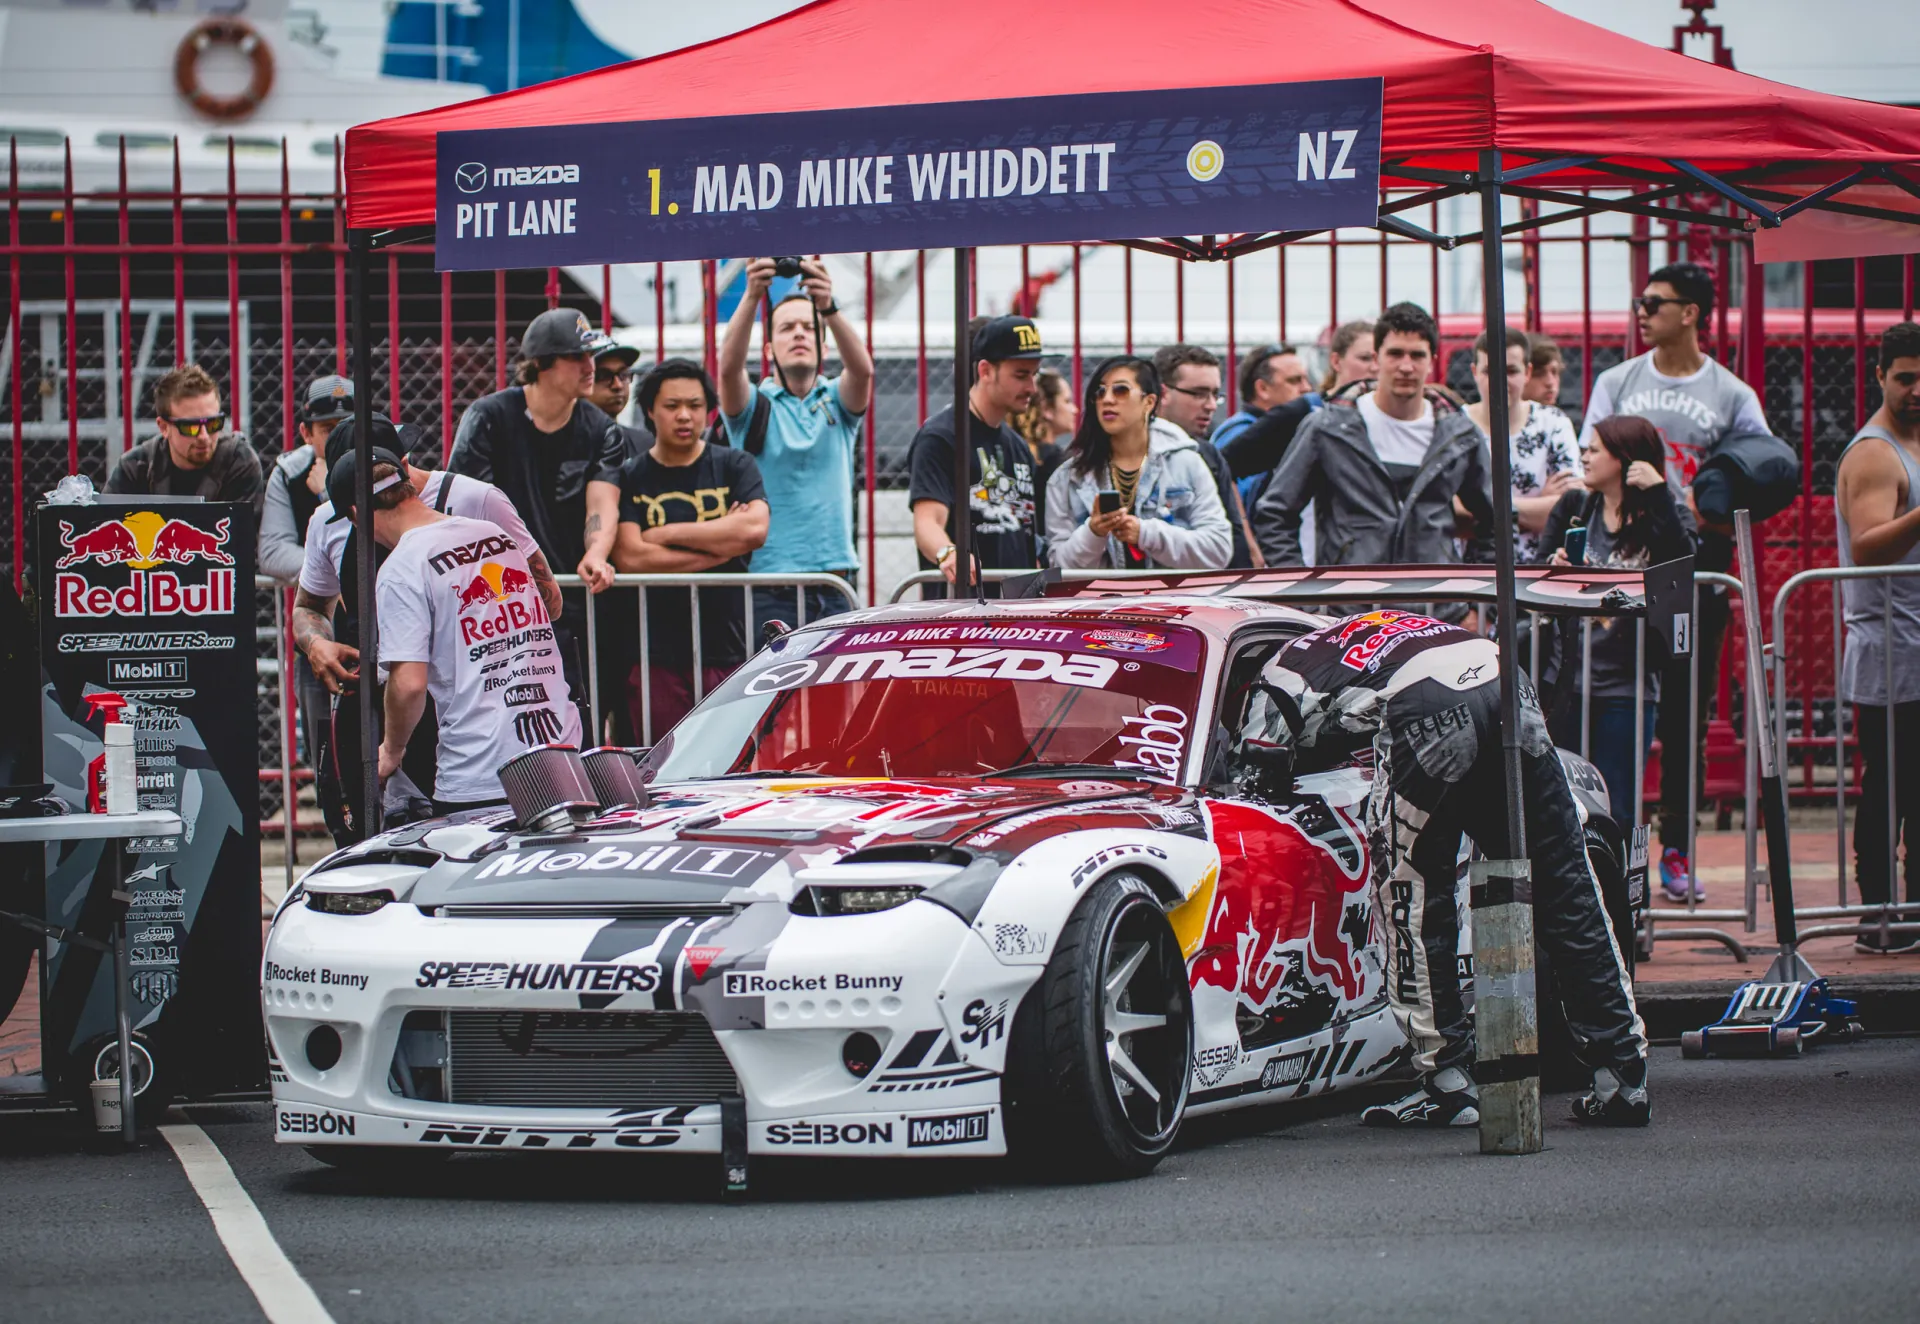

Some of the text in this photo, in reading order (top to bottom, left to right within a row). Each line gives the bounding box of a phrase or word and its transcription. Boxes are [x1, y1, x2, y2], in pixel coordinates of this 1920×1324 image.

[1297, 129, 1359, 182] NZ
[493, 164, 580, 188] mazda
[648, 142, 1116, 216] 1. MAD MIKE WHIDDETT
[456, 198, 578, 240] PIT LANE
[1619, 389, 1719, 431] KNIGHTS
[55, 567, 236, 617] Red Bull
[460, 604, 510, 646] Red
[845, 630, 899, 647] MAD
[899, 627, 959, 643] MIKE
[958, 626, 1074, 644] WHIDDETT
[1340, 618, 1402, 672] Red
[114, 663, 163, 680] Mobil
[492, 667, 532, 689] Rocket
[815, 646, 1121, 688] mazda
[911, 679, 989, 699] TAKATA
[137, 770, 175, 789] arrett
[474, 845, 683, 880] Mobil
[139, 898, 183, 906] RACING
[140, 889, 183, 899] MEGAN
[688, 948, 719, 960] TOW
[1389, 879, 1421, 1006] mazda
[272, 966, 370, 991] Rocket Bunny
[749, 973, 904, 992] Rocket Bunny
[1271, 1055, 1306, 1085] YAMAHA
[418, 1123, 681, 1149] NITTO
[912, 1117, 967, 1144] Mobil
